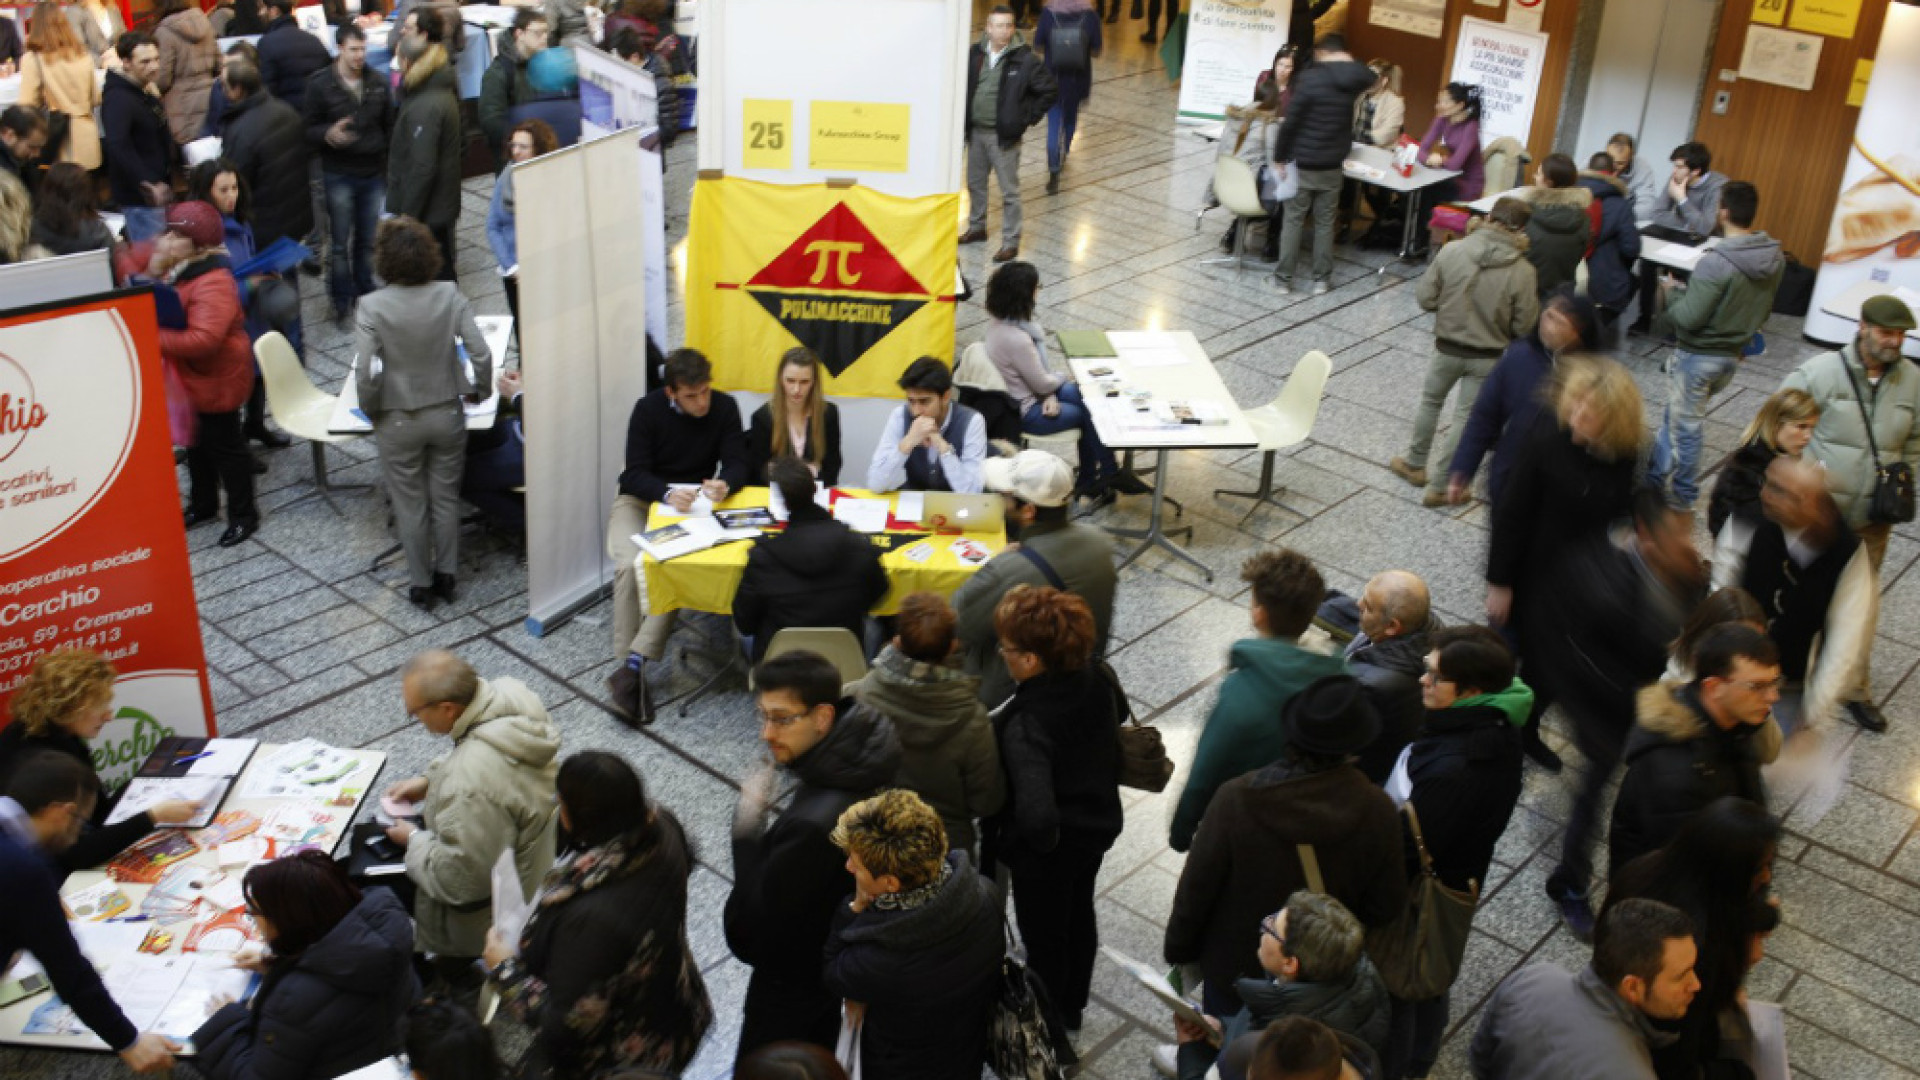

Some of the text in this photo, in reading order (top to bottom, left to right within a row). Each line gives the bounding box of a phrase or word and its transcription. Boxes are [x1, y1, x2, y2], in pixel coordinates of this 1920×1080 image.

[750, 121, 784, 150] 25
[780, 299, 892, 325] PULIMACCHINE
[0, 393, 48, 435] hio
[0, 466, 54, 492] cativi,
[92, 547, 152, 573] sociale
[0, 584, 100, 626] Cerchio
[0, 636, 28, 653] cia,
[73, 602, 153, 632] Cremona
[93, 719, 175, 772] erchio
